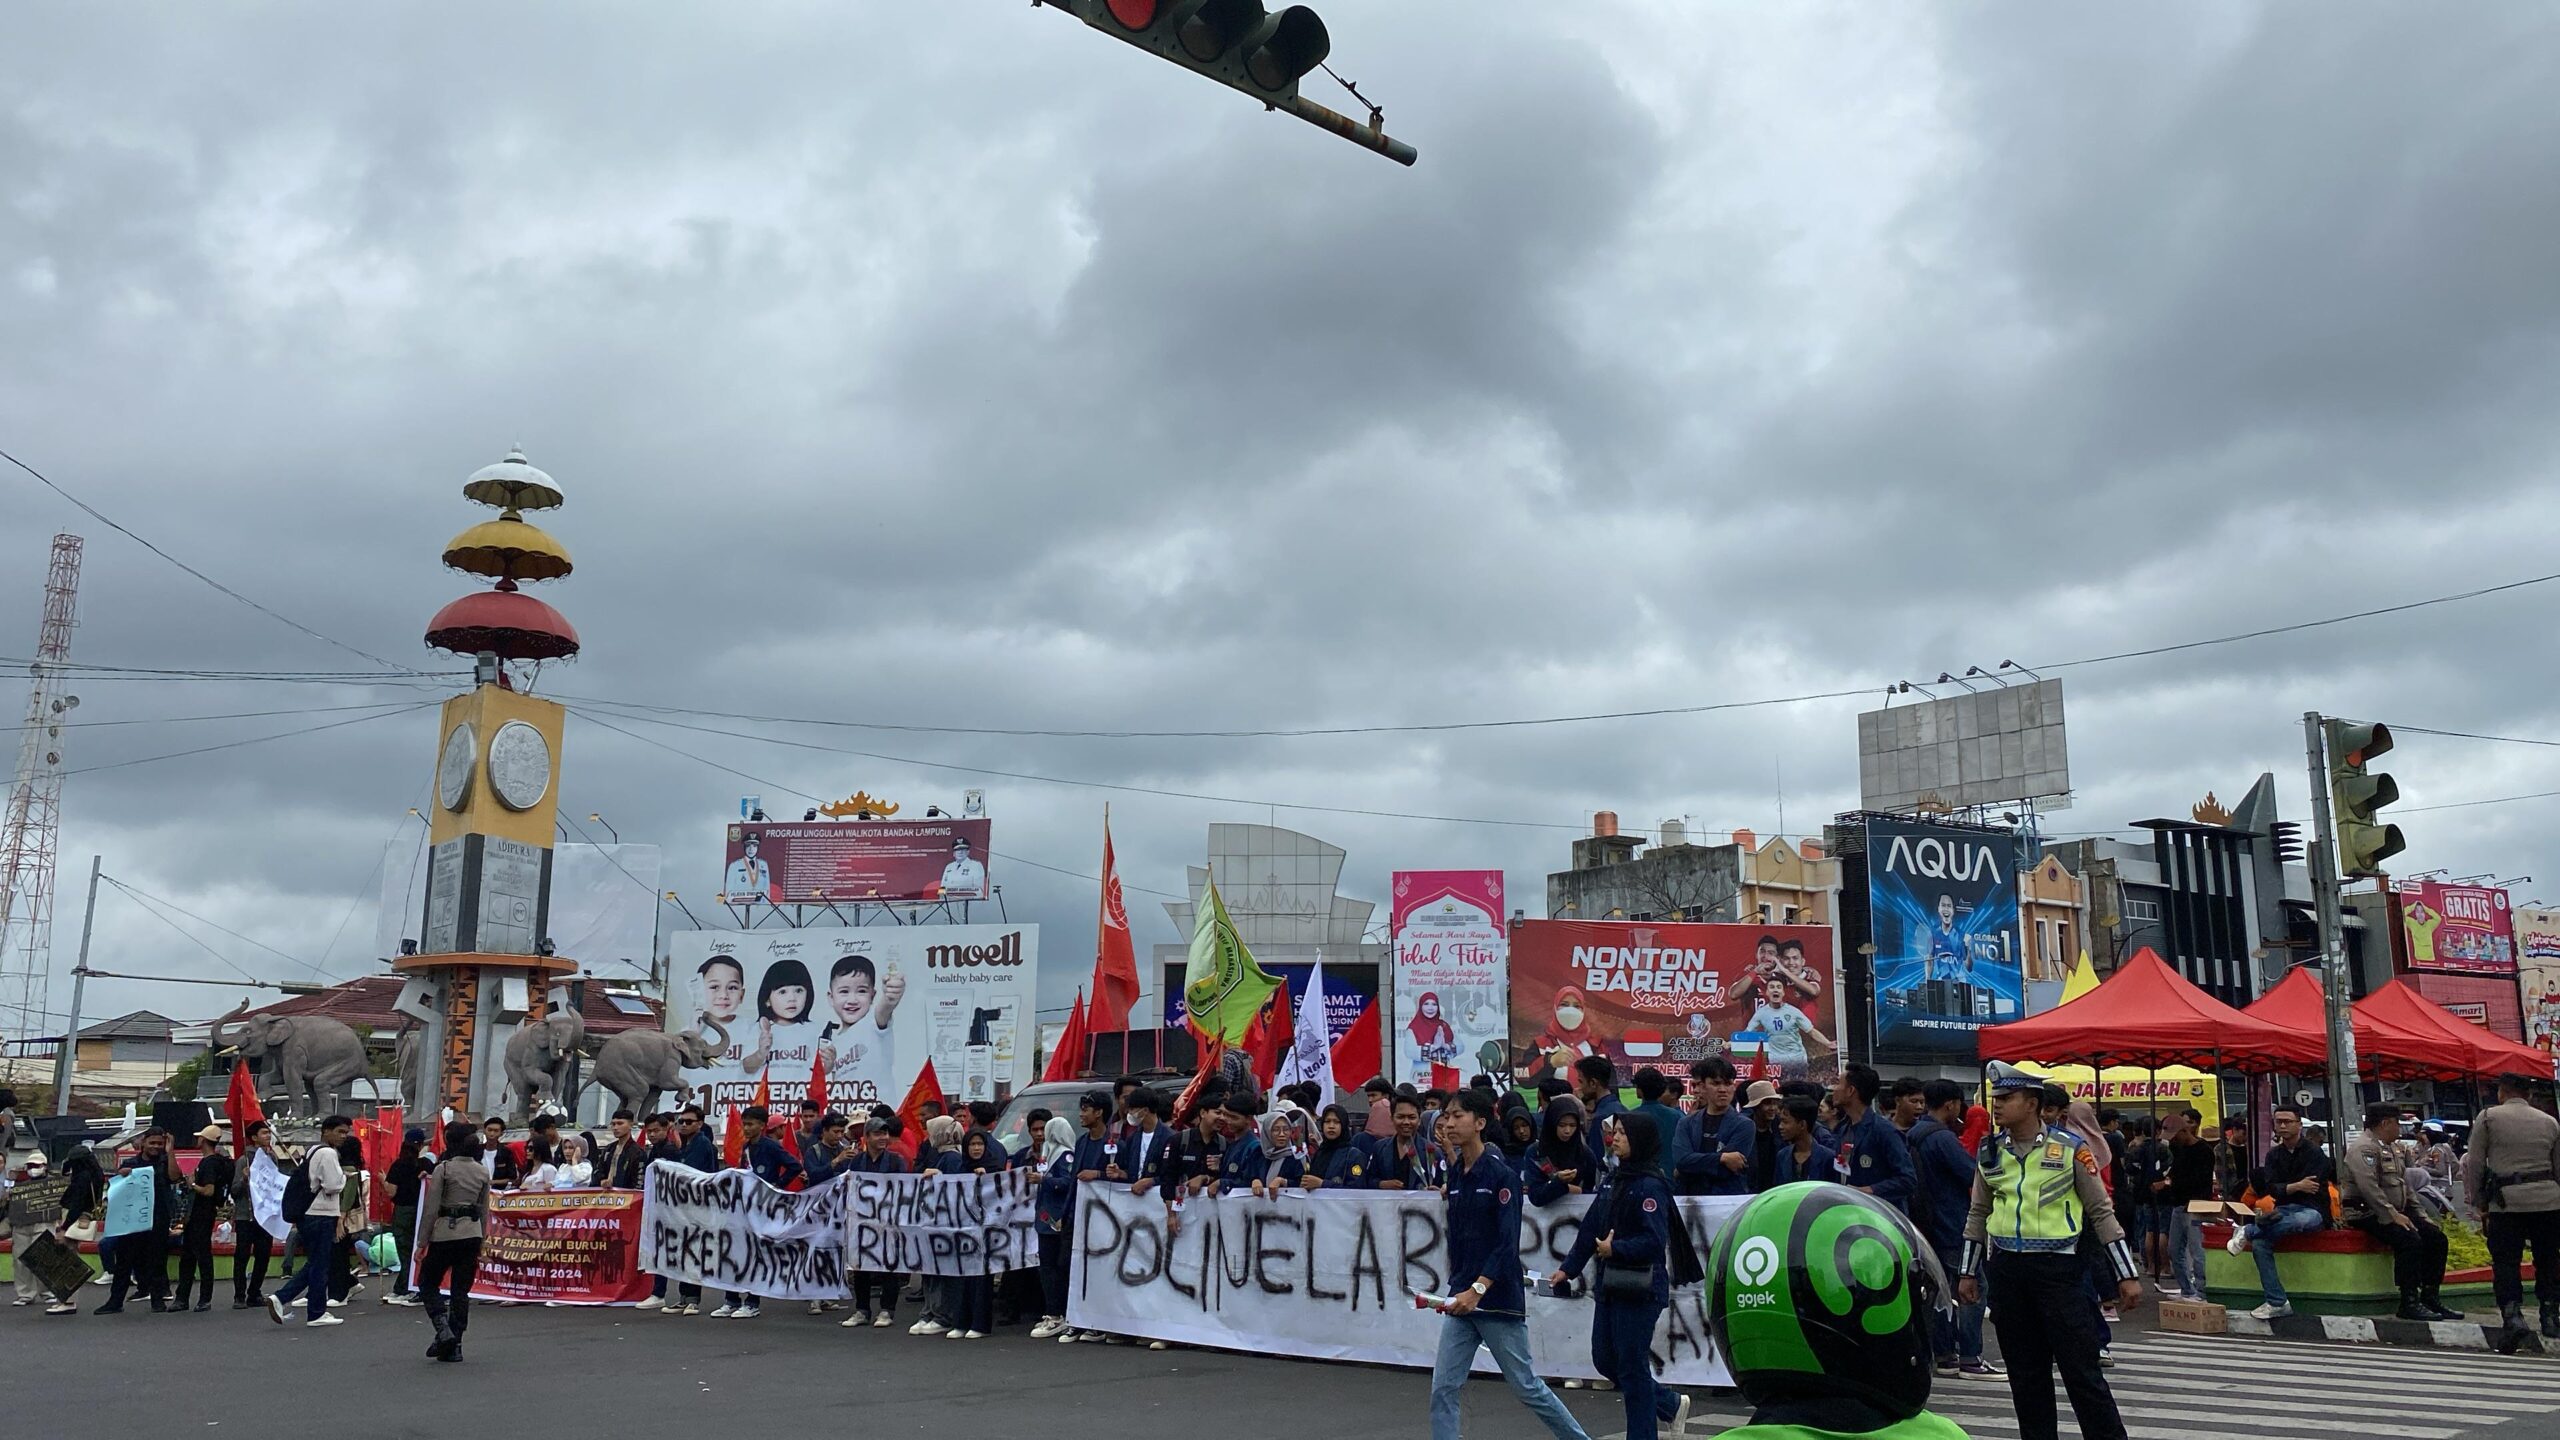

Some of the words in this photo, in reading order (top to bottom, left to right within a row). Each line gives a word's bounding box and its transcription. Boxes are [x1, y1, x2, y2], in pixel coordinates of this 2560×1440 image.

[765, 829, 802, 838] PROGRAM
[803, 829, 844, 838] UNGGULAN
[845, 828, 882, 838] WALIKOTA
[883, 828, 914, 837] BANDAR
[915, 827, 951, 837] LAMPUNG
[498, 841, 530, 857] ADIPURA
[1885, 836, 2002, 884] AQUA
[2445, 896, 2490, 922] GRATIS
[1410, 931, 1443, 939] Selamat
[1445, 931, 1466, 939] Hari
[1467, 931, 1491, 940] Raya
[1973, 933, 2000, 943] GLOBAL
[926, 932, 1023, 968] moell
[1395, 943, 1442, 967] Idul
[1449, 942, 1498, 967] Fitri
[1974, 930, 2012, 962] NO.1
[1571, 945, 1706, 971] NONTON
[934, 972, 967, 984] healthy
[969, 972, 991, 984] baby
[993, 973, 1013, 982] care
[1585, 969, 1719, 993] BARENG
[1294, 994, 1362, 1006] SAMAT
[1631, 986, 1725, 1017] Semifinal
[1773, 1020, 1783, 1031] 19
[1912, 1019, 1939, 1029] INSPIRE
[1940, 1020, 1967, 1030] FUTURE
[861, 1082, 876, 1101] &
[2041, 1161, 2064, 1169] POLRI
[653, 1164, 746, 1215] PENGUASA
[499, 1197, 555, 1208] RAKYAT
[562, 1196, 625, 1207] MELAWAN
[857, 1175, 986, 1228] SAHKAN
[518, 1218, 543, 1229] MEI
[547, 1218, 620, 1230] BERLAWAN
[503, 1237, 562, 1250] PERSATUAN
[566, 1240, 607, 1251] BURUH
[654, 1219, 769, 1283] PEKERJA
[858, 1224, 923, 1272] RUU
[928, 1221, 1036, 1275] PPRT
[503, 1251, 519, 1260] UU
[520, 1251, 592, 1264] CIPTAKERJA
[479, 1262, 514, 1277] RABU,
[517, 1266, 524, 1275] 1
[526, 1267, 546, 1278] MEI
[550, 1269, 582, 1279] 2024
[1736, 1290, 1776, 1308] gojek
[2163, 1308, 2196, 1321] GRAND
